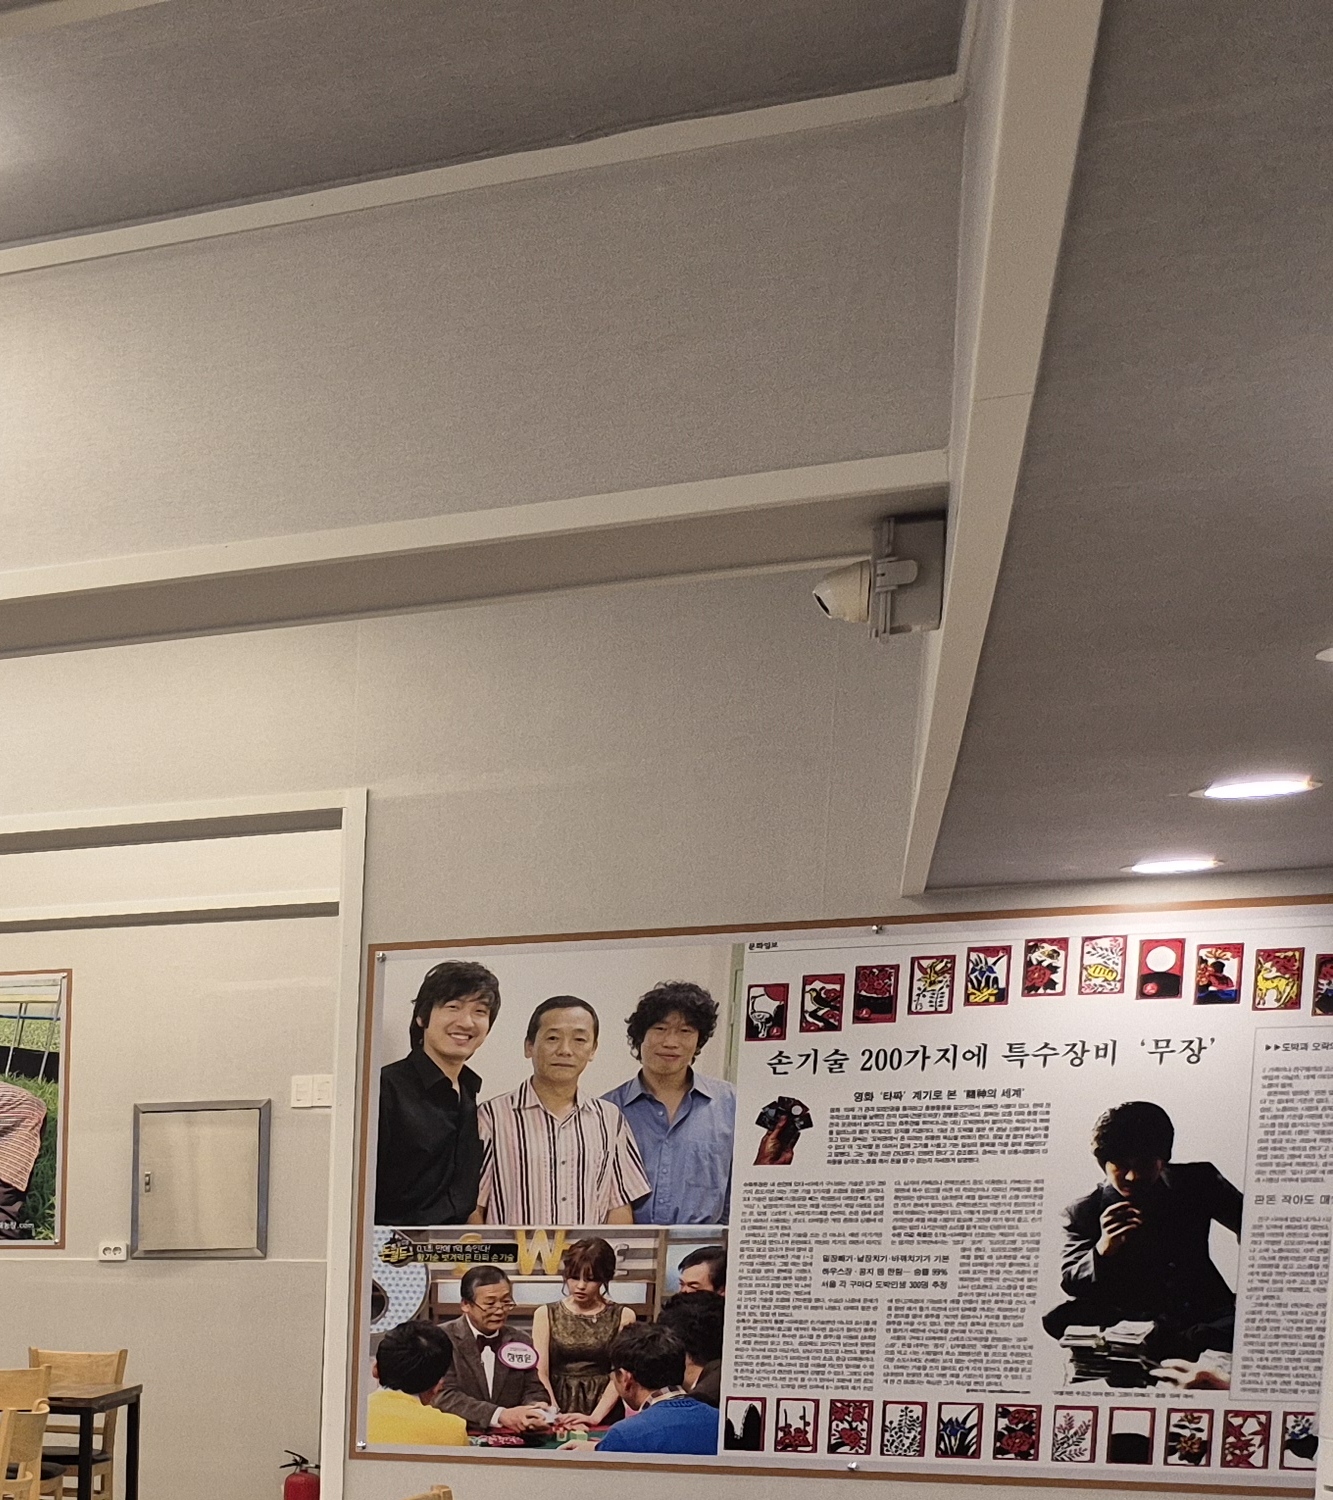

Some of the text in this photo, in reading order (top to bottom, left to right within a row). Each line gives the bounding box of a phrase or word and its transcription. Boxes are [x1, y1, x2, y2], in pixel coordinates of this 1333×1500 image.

[766, 1036, 1216, 1076] 손기술 200가지에 특수장비 '무장'
[853, 1091, 874, 1103] 영화
[880, 1090, 906, 1102] '타짜'
[912, 1090, 943, 1101] 계기로
[947, 1089, 958, 1100] 본
[1001, 1087, 1025, 1099] 세계'
[1281, 1194, 1315, 1205] 작아도
[933, 1254, 950, 1264] 기본
[821, 1280, 837, 1289] 서울
[838, 1280, 847, 1289] 각
[849, 1280, 873, 1289] 구마다
[931, 1280, 948, 1290] 추정
